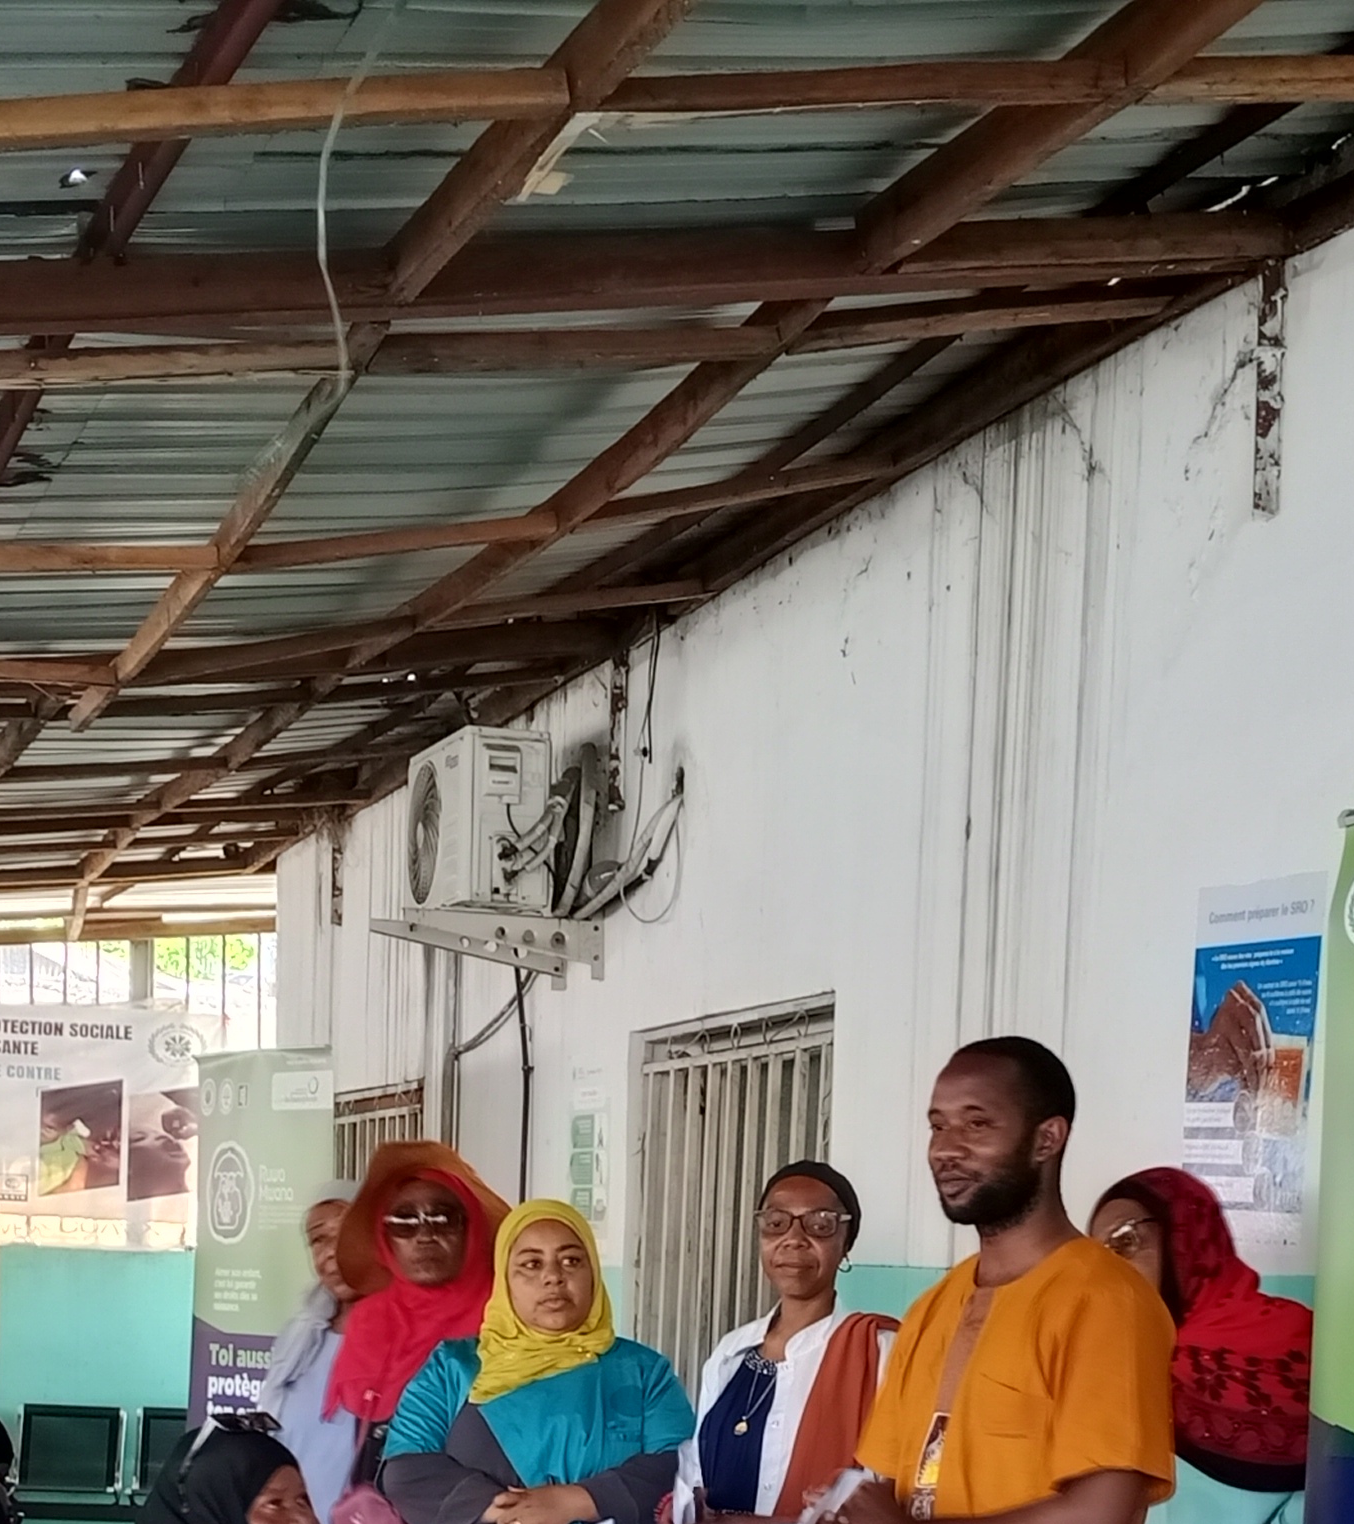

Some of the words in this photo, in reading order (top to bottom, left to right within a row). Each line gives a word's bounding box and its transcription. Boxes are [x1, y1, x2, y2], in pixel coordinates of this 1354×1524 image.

[68, 1022, 133, 1041] SOCIALE
[209, 1343, 234, 1367] Toi
[236, 1346, 274, 1369] auss
[207, 1372, 266, 1402] protèg
